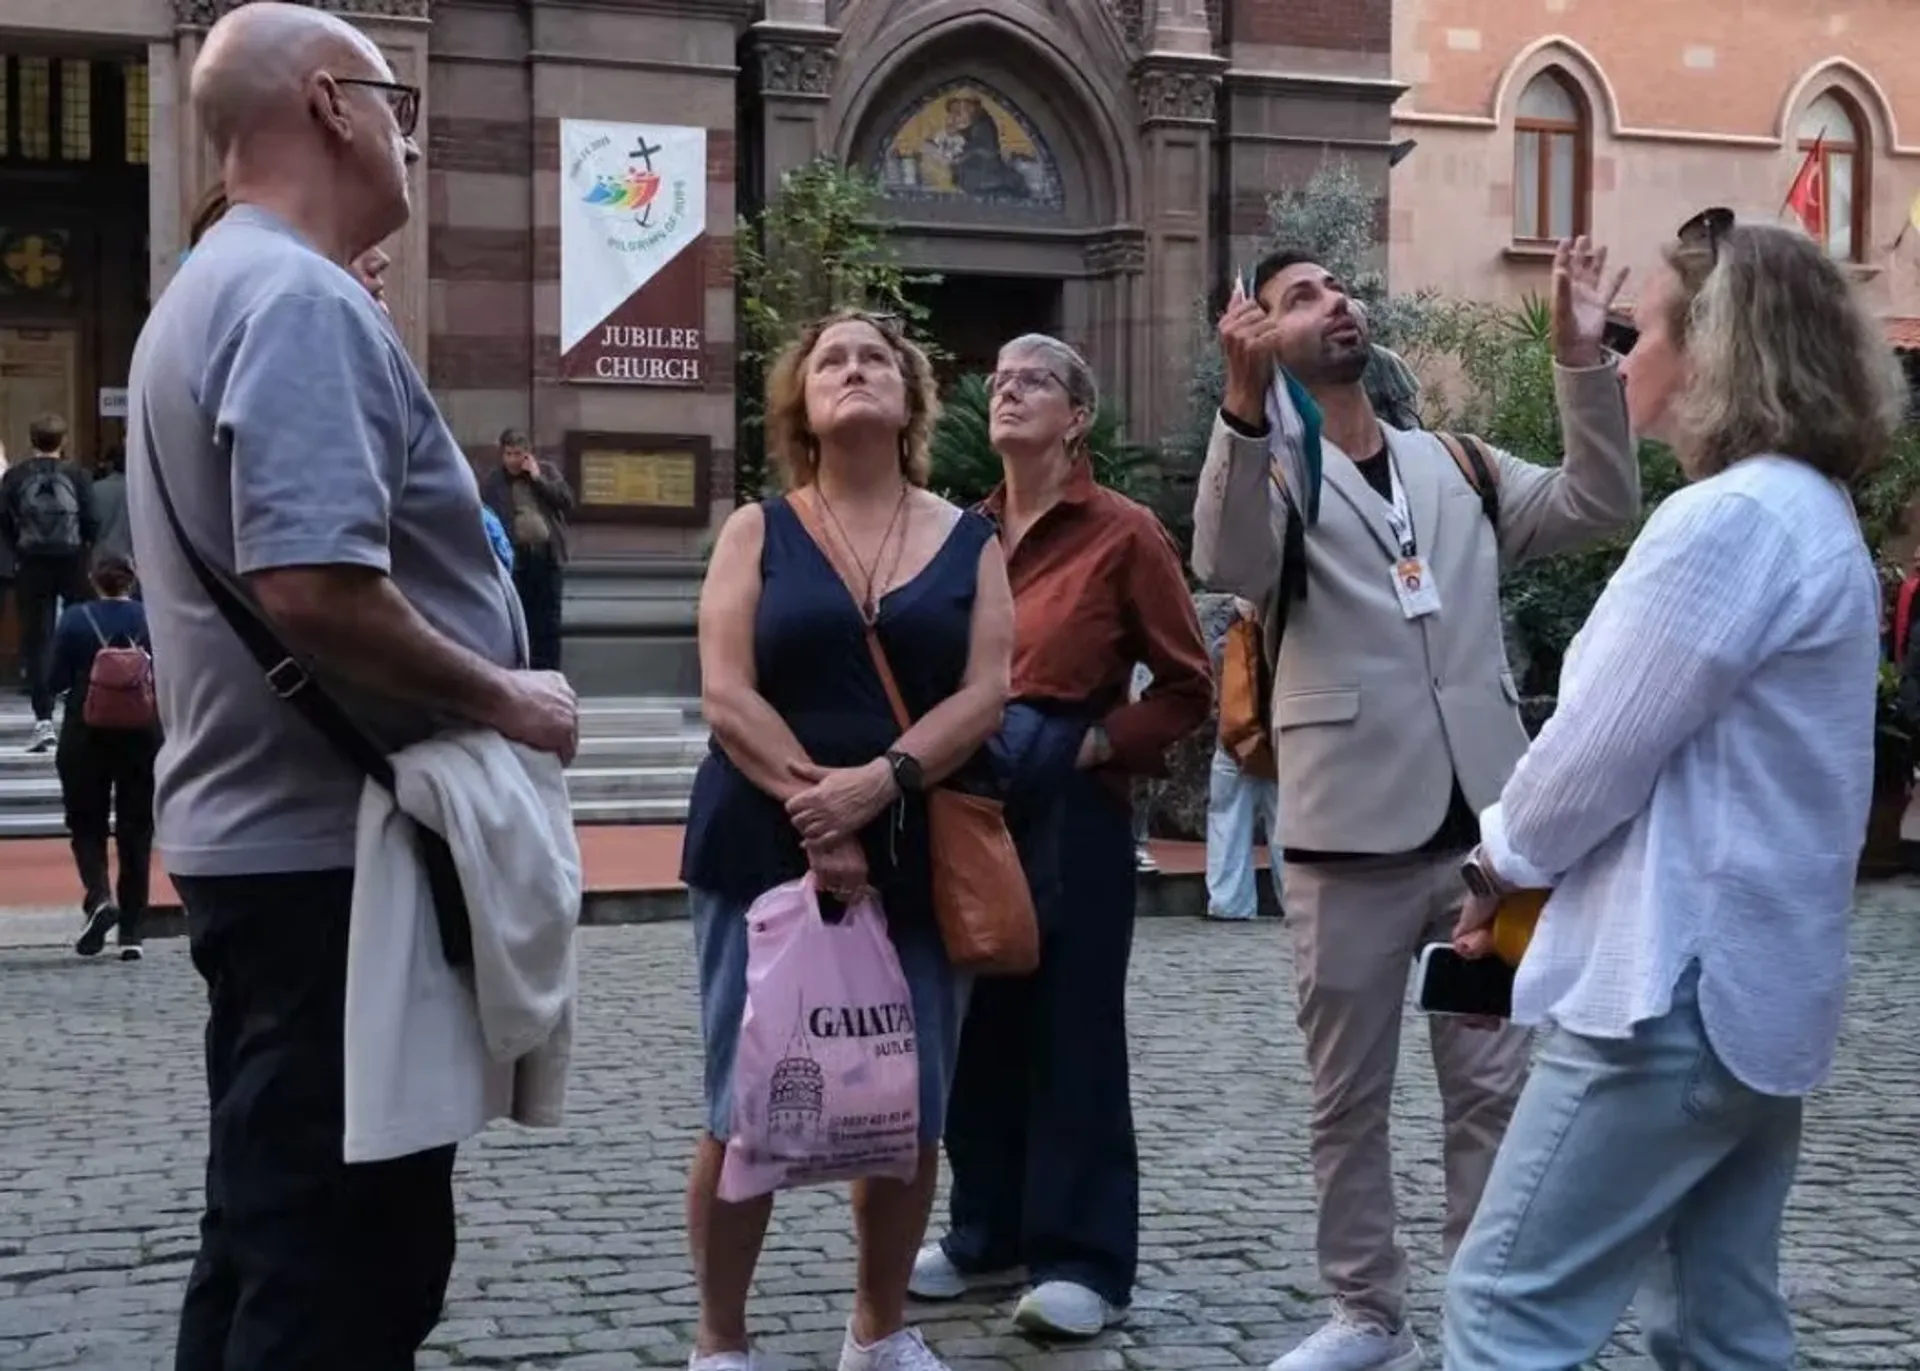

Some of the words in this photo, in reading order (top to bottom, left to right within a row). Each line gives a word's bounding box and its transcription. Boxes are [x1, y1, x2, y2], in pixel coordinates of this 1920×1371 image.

[600, 325, 700, 350] JUBILEE
[596, 356, 699, 380] CHURCH
[809, 1003, 914, 1038] GALATA
